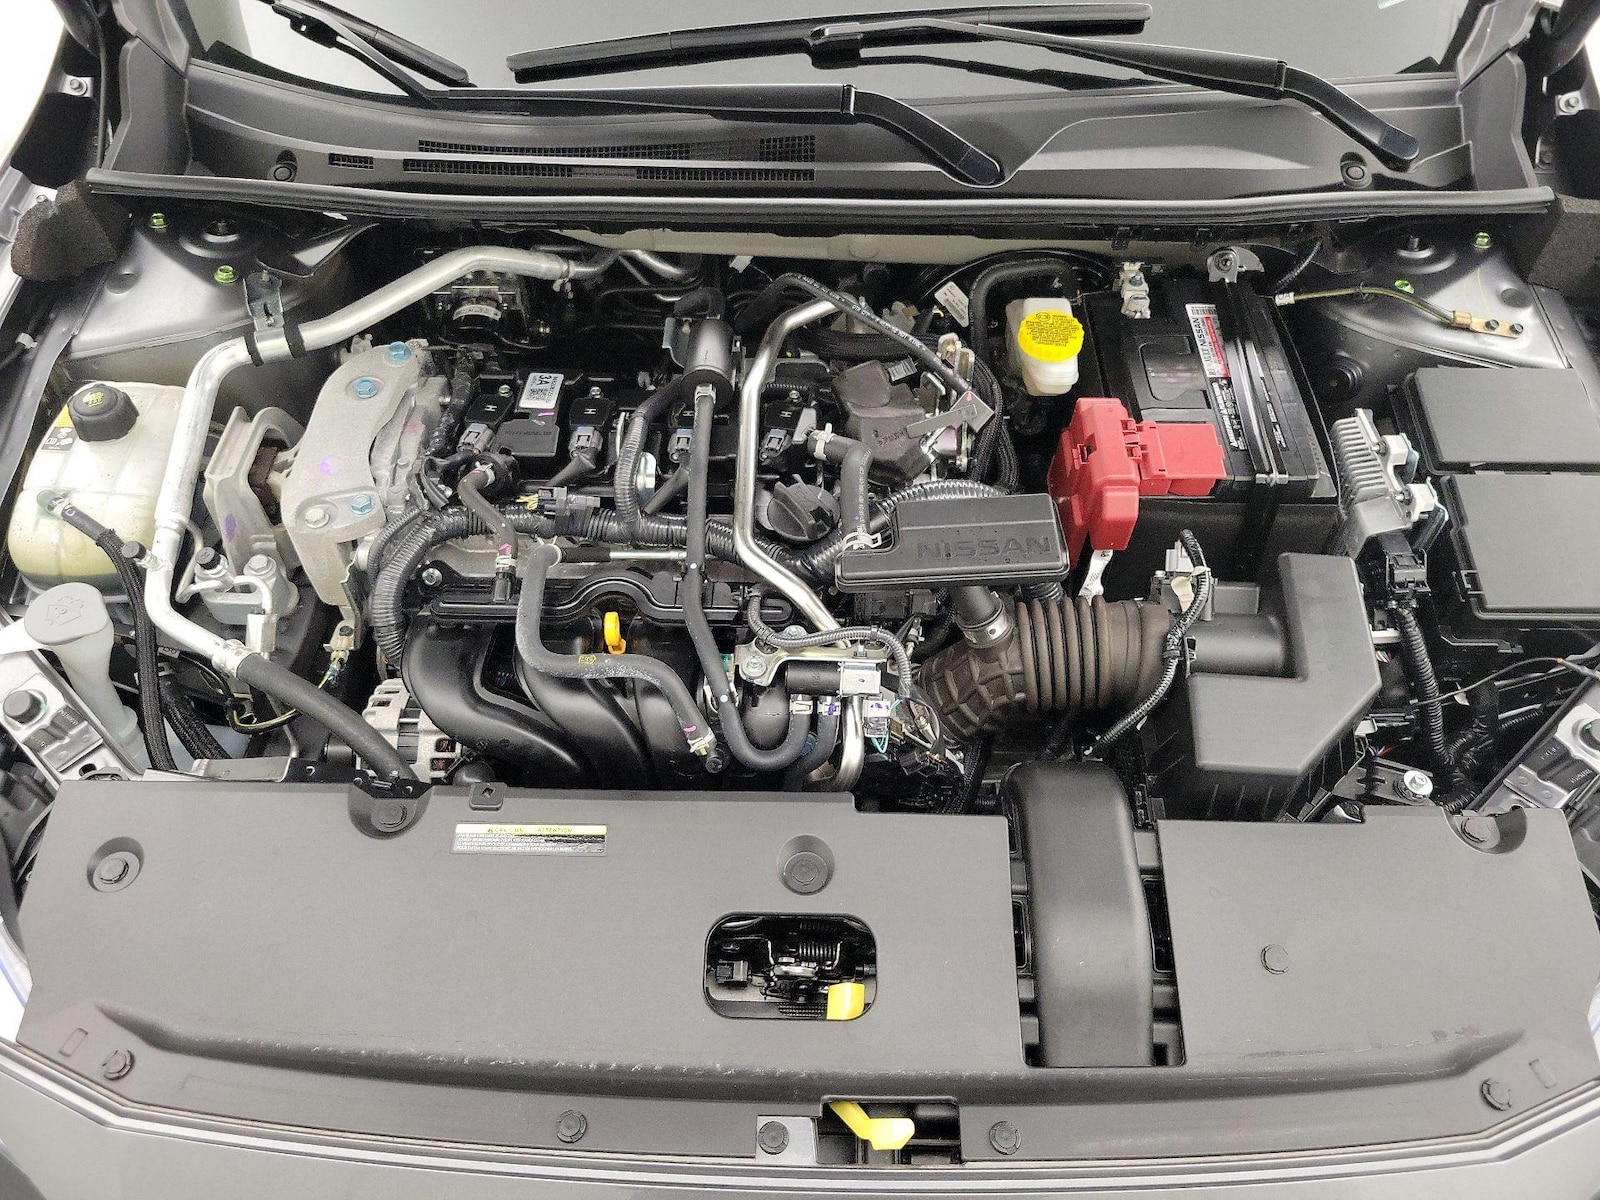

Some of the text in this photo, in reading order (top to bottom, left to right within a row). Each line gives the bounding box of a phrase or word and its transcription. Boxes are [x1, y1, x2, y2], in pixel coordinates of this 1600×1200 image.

[1191, 317, 1208, 347] NISSAN
[537, 374, 552, 386] 3A
[918, 537, 1051, 559] NISSAN
